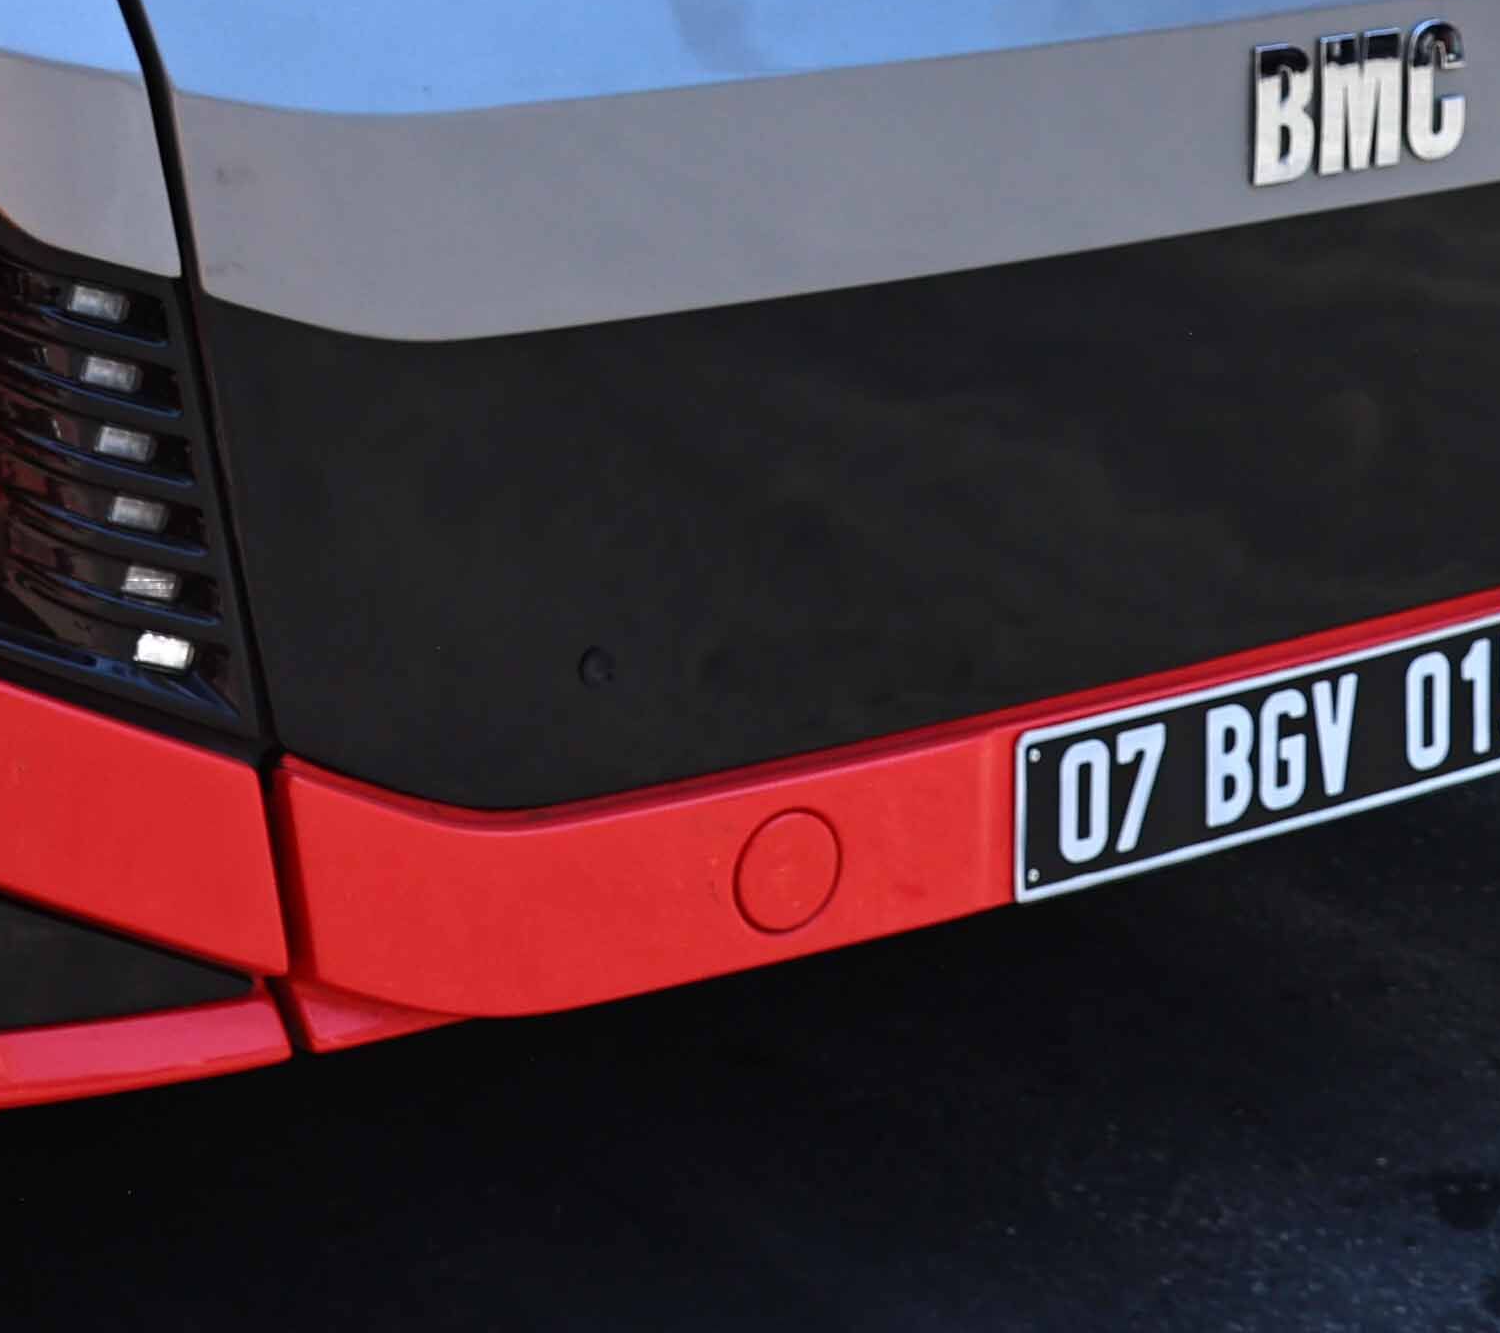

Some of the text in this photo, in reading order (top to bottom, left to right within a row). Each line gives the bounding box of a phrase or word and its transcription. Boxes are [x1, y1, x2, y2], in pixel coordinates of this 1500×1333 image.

[1252, 17, 1467, 187] BMC
[1058, 722, 1167, 864] 07
[1205, 672, 1359, 829] BGV
